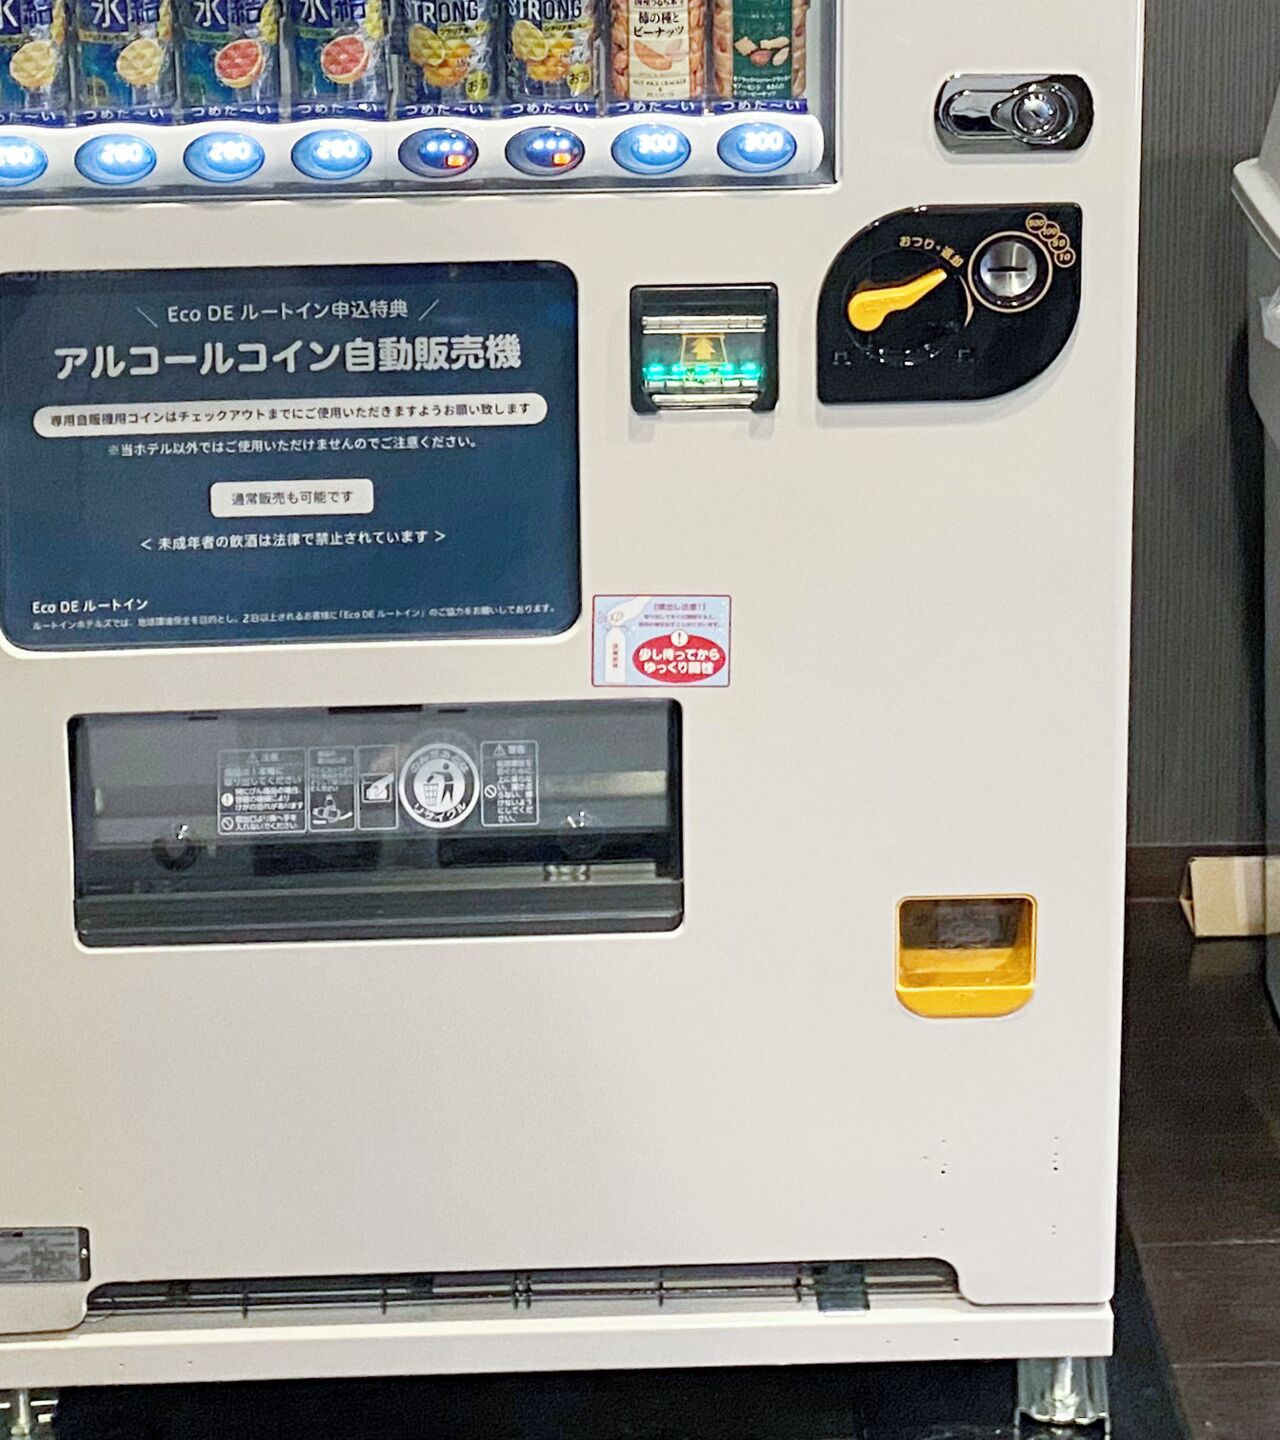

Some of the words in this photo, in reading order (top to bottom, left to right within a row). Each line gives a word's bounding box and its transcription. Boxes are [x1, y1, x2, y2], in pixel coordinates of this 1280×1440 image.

[404, 0, 478, 24] STRONG
[638, 12, 680, 24] 柿の種と
[633, 25, 685, 38] ピーナッツ
[639, 133, 677, 153] 300
[745, 131, 784, 152] 300
[1053, 240, 1066, 248] 50
[1059, 253, 1071, 261] 10
[167, 305, 201, 323] Eco
[208, 304, 234, 322] DE
[240, 299, 408, 321] ルートイン申込特典
[55, 333, 521, 380] アルコールコイン自動販売機
[231, 491, 353, 506] 通常販売も可能です
[32, 602, 56, 614] Eco
[60, 601, 79, 613] DE
[83, 598, 148, 613] ルートイン
[639, 648, 720, 661] 少し待ってから
[413, 802, 467, 821] リサイクル
